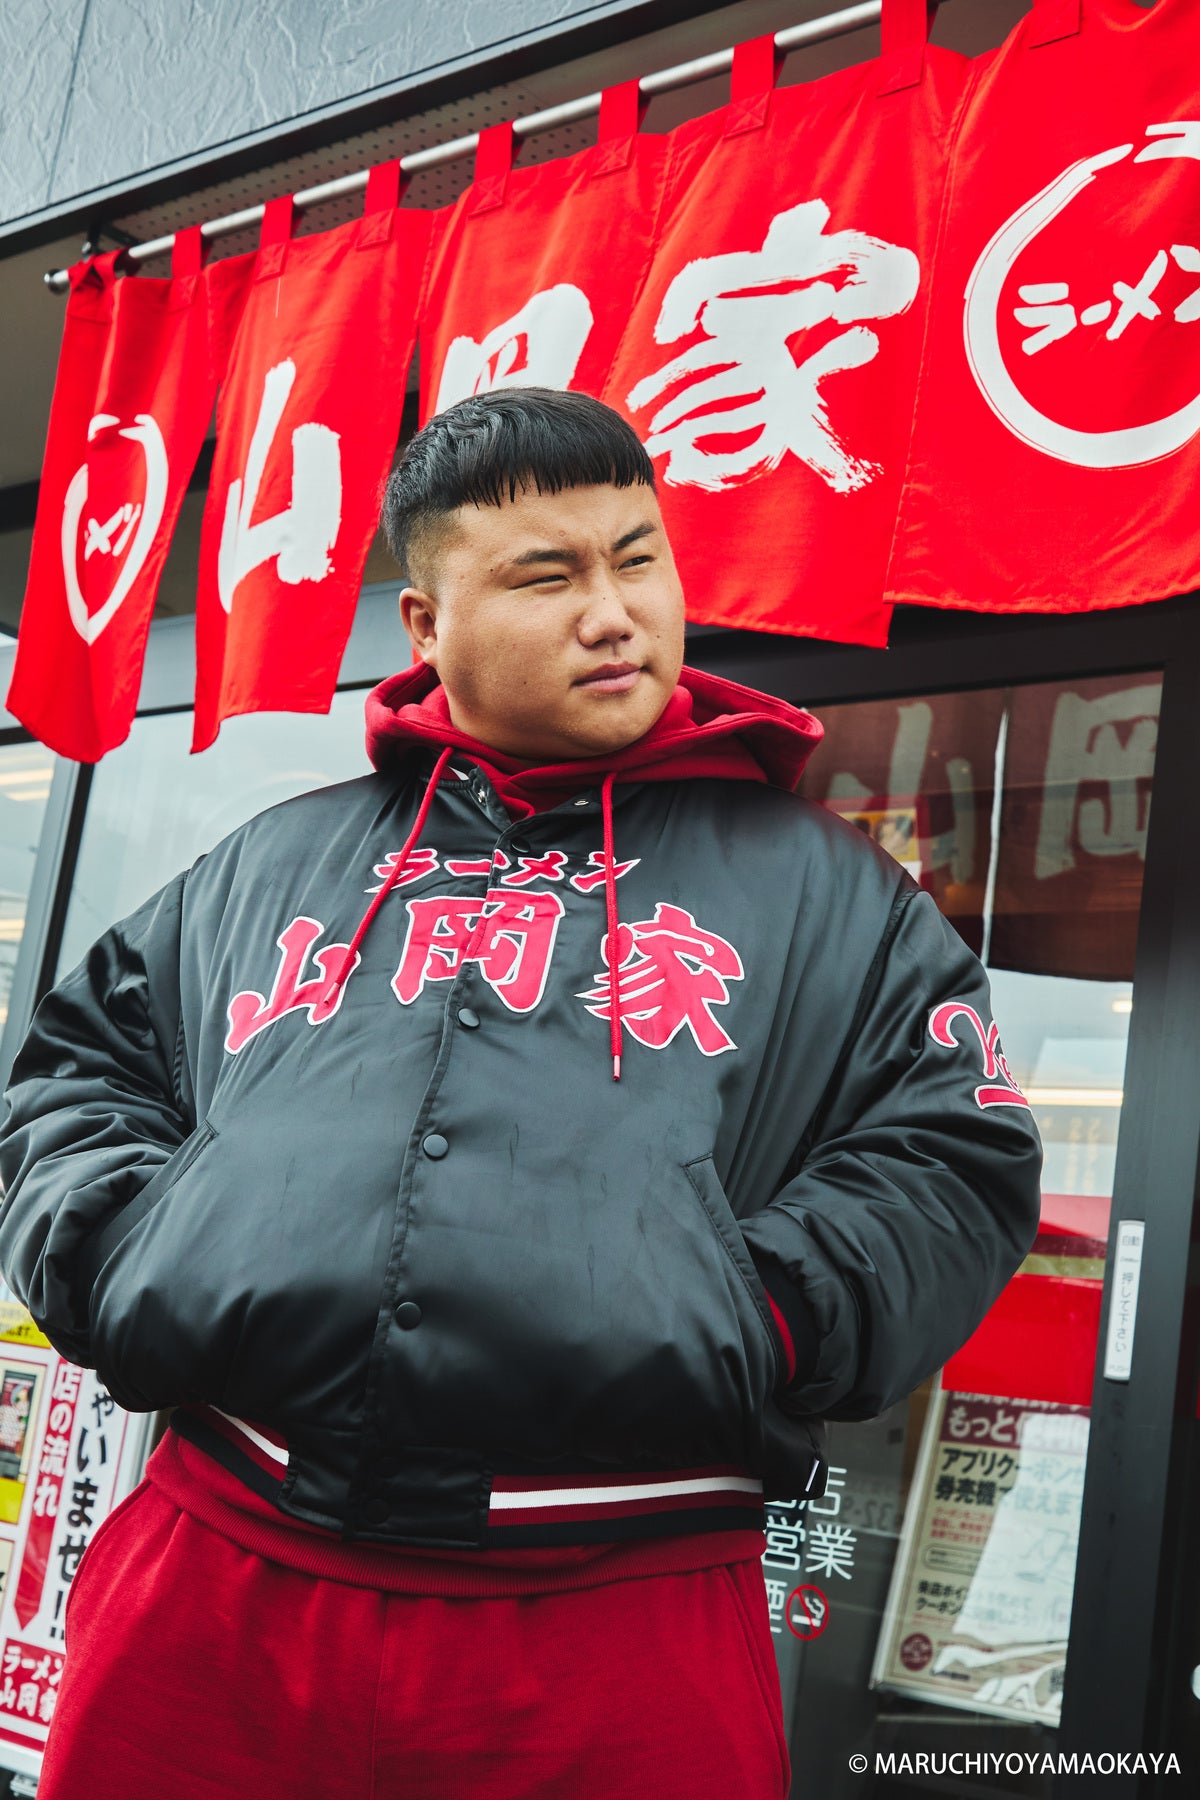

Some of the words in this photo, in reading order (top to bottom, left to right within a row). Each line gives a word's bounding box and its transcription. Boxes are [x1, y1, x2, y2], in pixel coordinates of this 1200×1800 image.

[364, 848, 641, 894] ラーメン
[224, 888, 745, 1057] 山岡家
